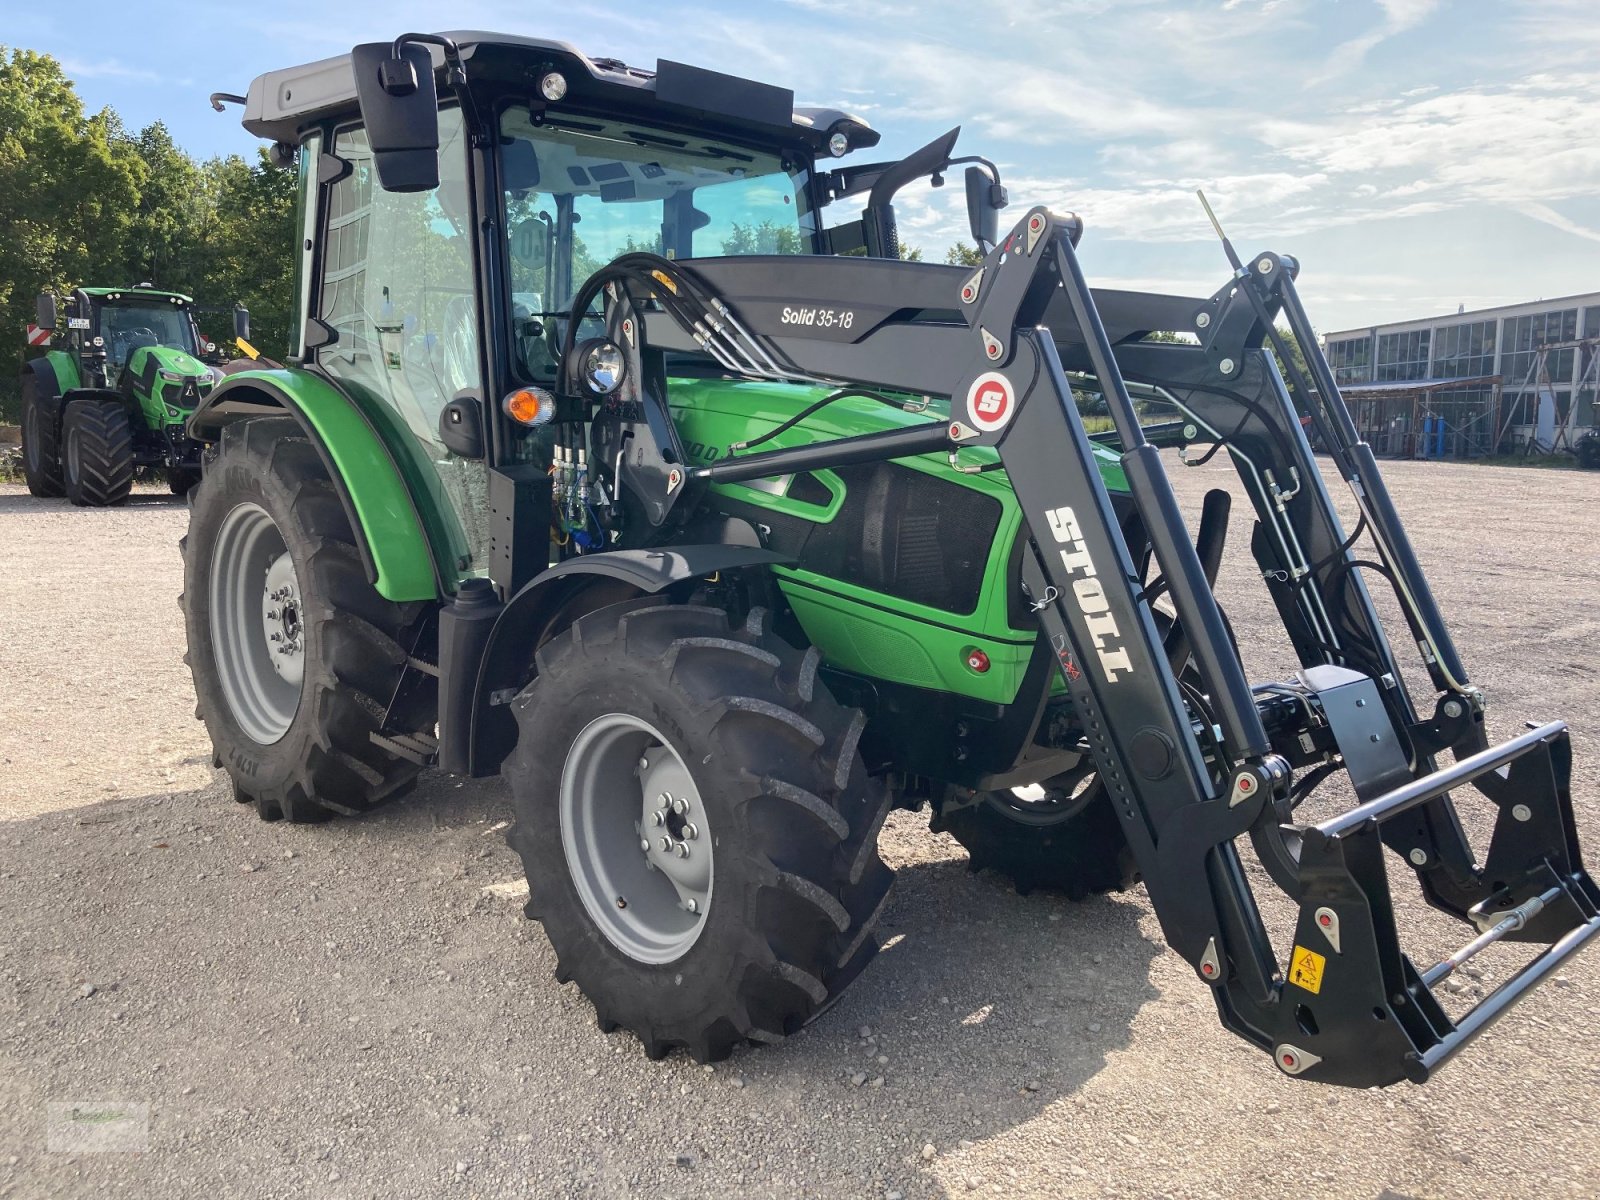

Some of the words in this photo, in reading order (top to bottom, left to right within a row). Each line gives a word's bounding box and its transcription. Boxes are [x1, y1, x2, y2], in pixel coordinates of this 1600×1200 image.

[781, 307, 816, 326] Solid
[816, 309, 854, 329] 35-18
[1045, 506, 1134, 683] STOLL
